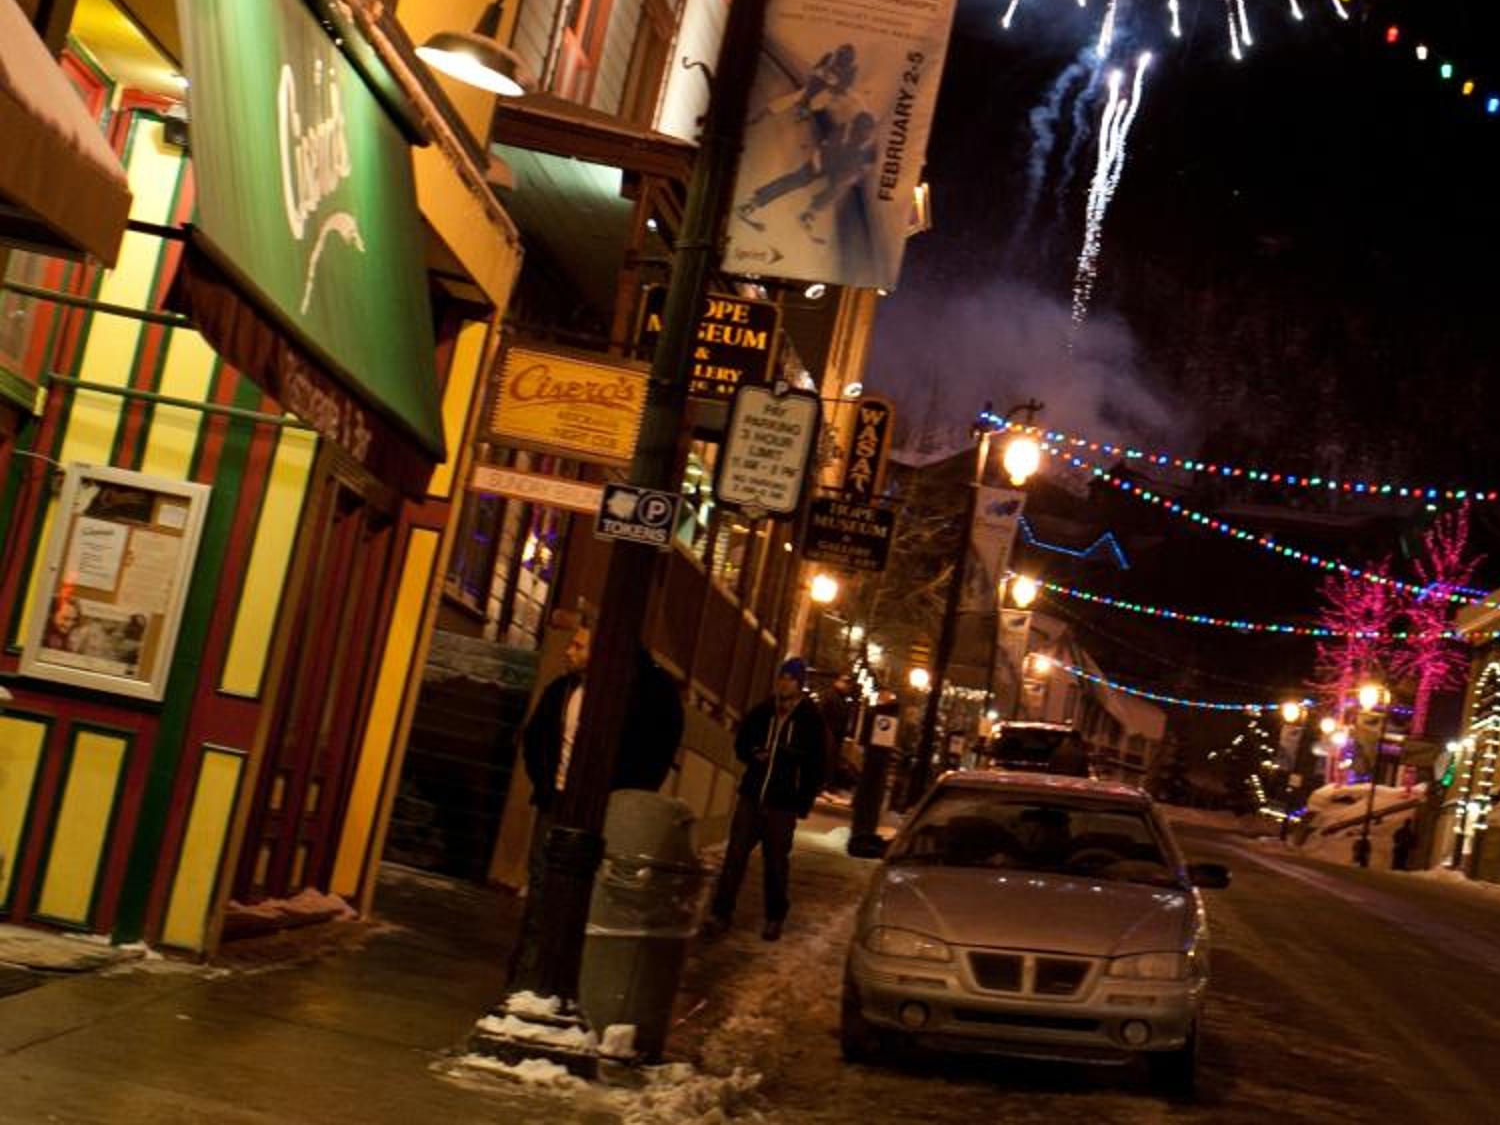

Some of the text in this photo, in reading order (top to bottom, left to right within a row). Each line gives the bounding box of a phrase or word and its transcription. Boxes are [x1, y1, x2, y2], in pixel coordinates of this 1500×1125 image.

[878, 51, 925, 202] FEBRUARY 2-5
[703, 298, 750, 324] OPE
[509, 364, 636, 402] Cisero's
[693, 363, 743, 383] LERY
[744, 414, 802, 435] PARKING
[754, 431, 793, 447] HOUR
[849, 407, 886, 493] WASAT
[749, 444, 784, 461] LIMIT
[646, 500, 665, 519] P
[602, 518, 667, 543] TOKENS
[814, 513, 889, 538] MUSEUM
